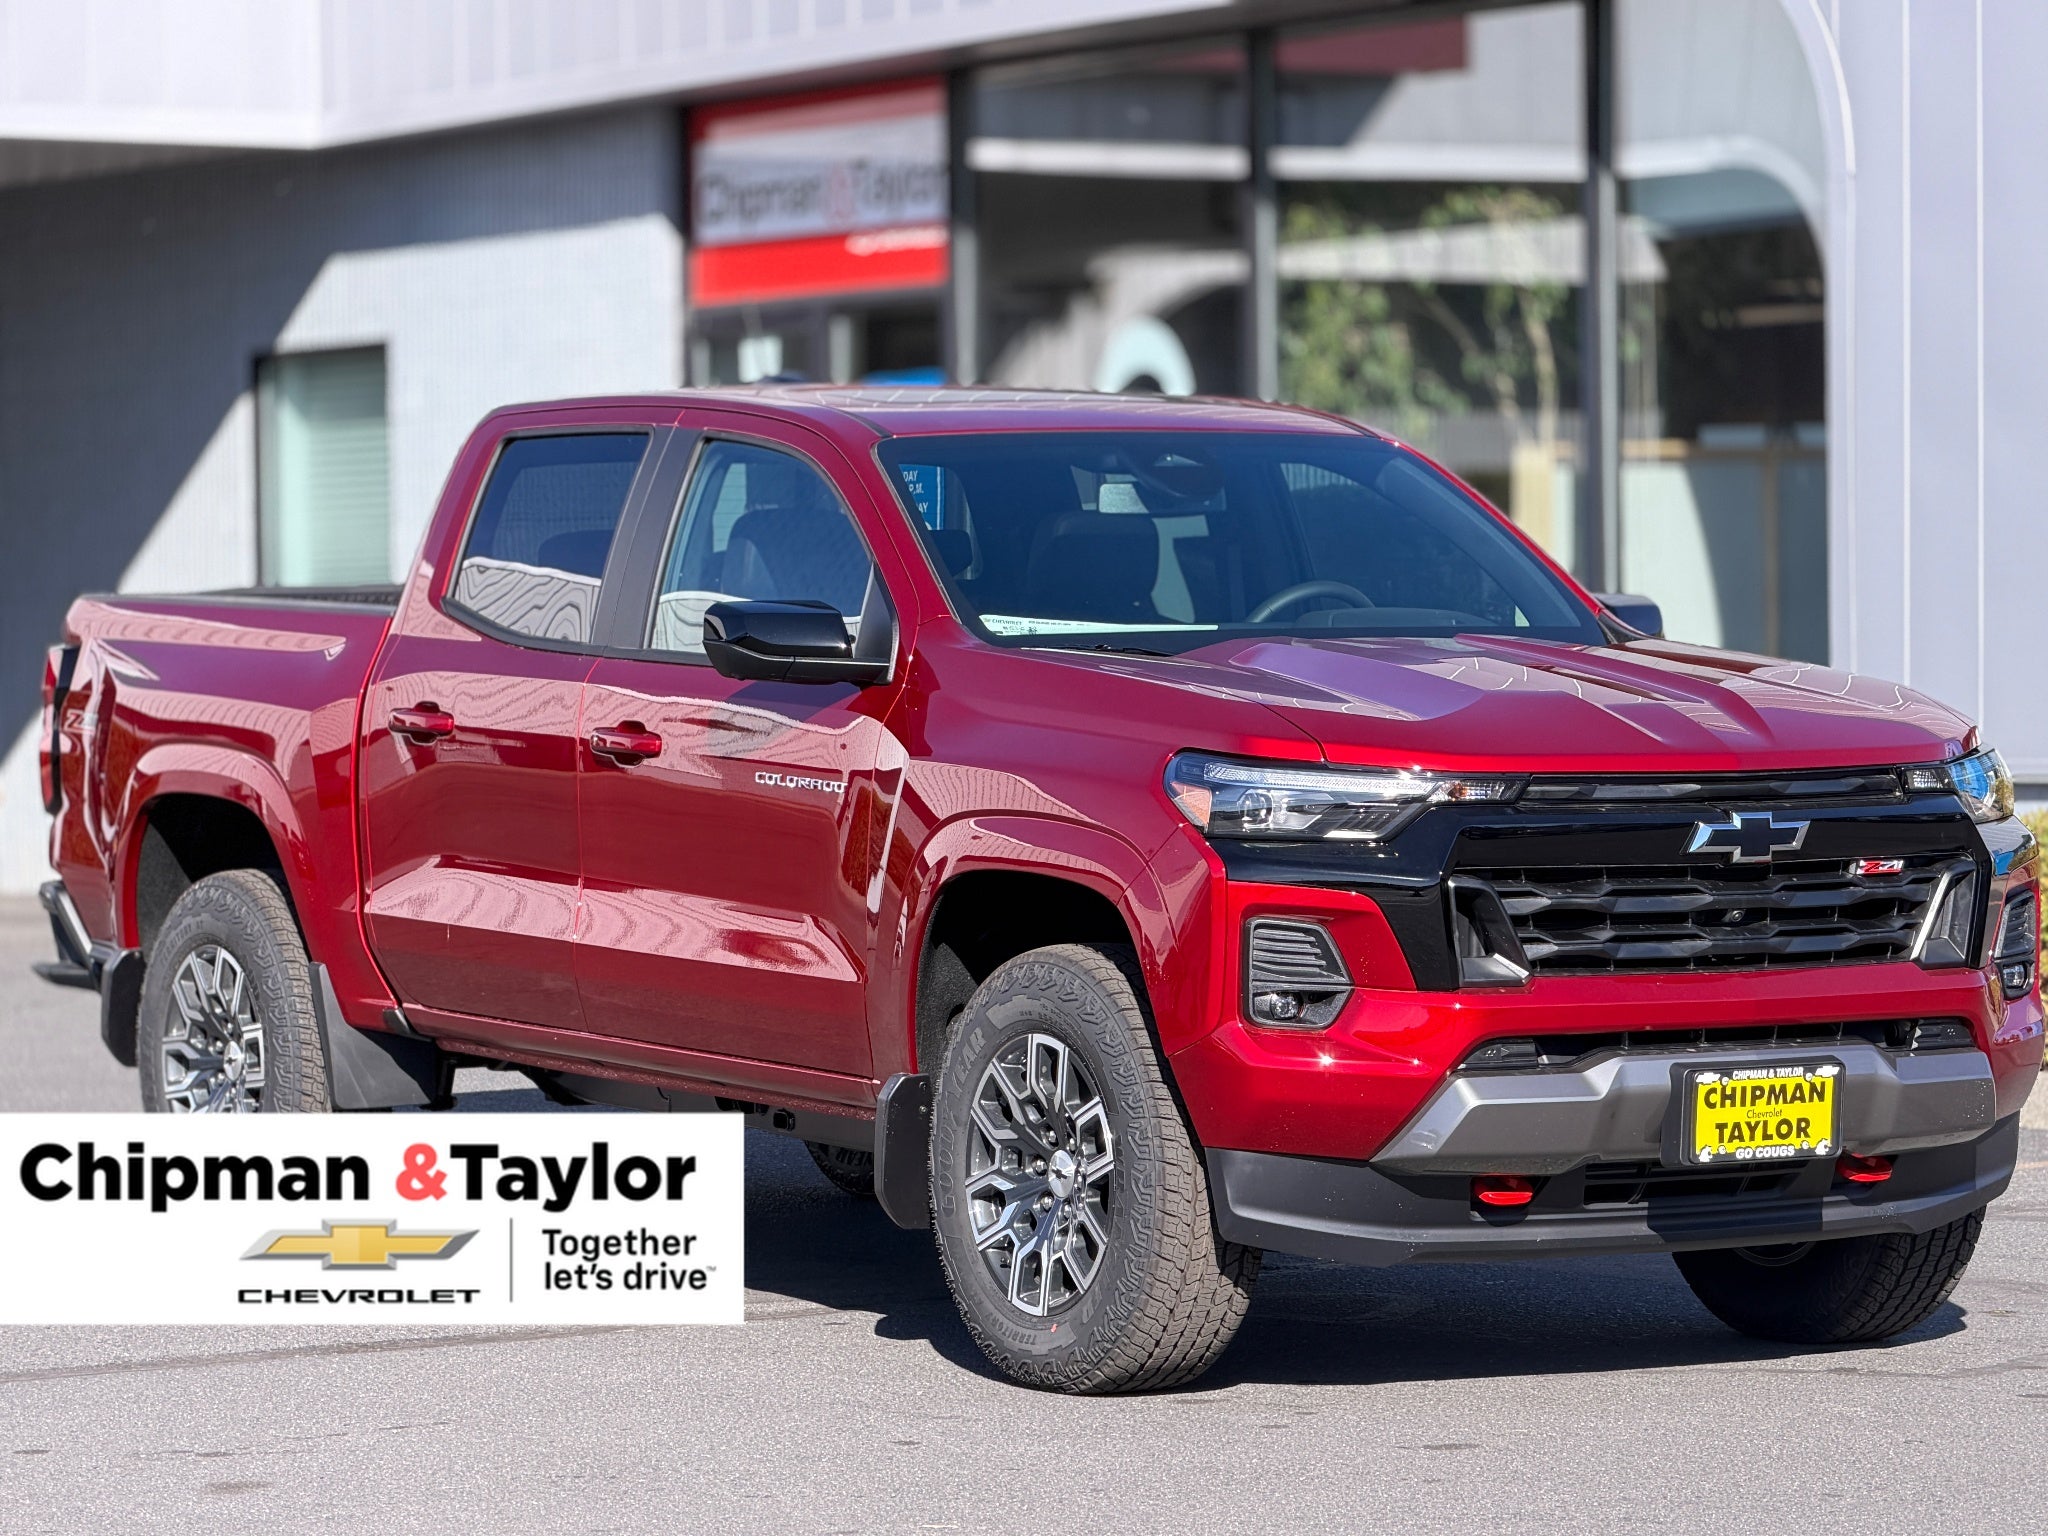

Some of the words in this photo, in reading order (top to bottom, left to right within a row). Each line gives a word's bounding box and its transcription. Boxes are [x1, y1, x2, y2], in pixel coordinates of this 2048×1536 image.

[755, 771, 848, 793] COLORADO
[1732, 1068, 1767, 1081] CHIPMAN
[1768, 1068, 1775, 1078] &
[1776, 1067, 1804, 1078] TAYLOR
[1704, 1081, 1826, 1109] CHIPMAN
[1746, 1108, 1783, 1119] Chevrolet
[1715, 1117, 1811, 1143] TAYLOR
[1735, 1147, 1753, 1159] GO
[1755, 1145, 1795, 1158] COUGS
